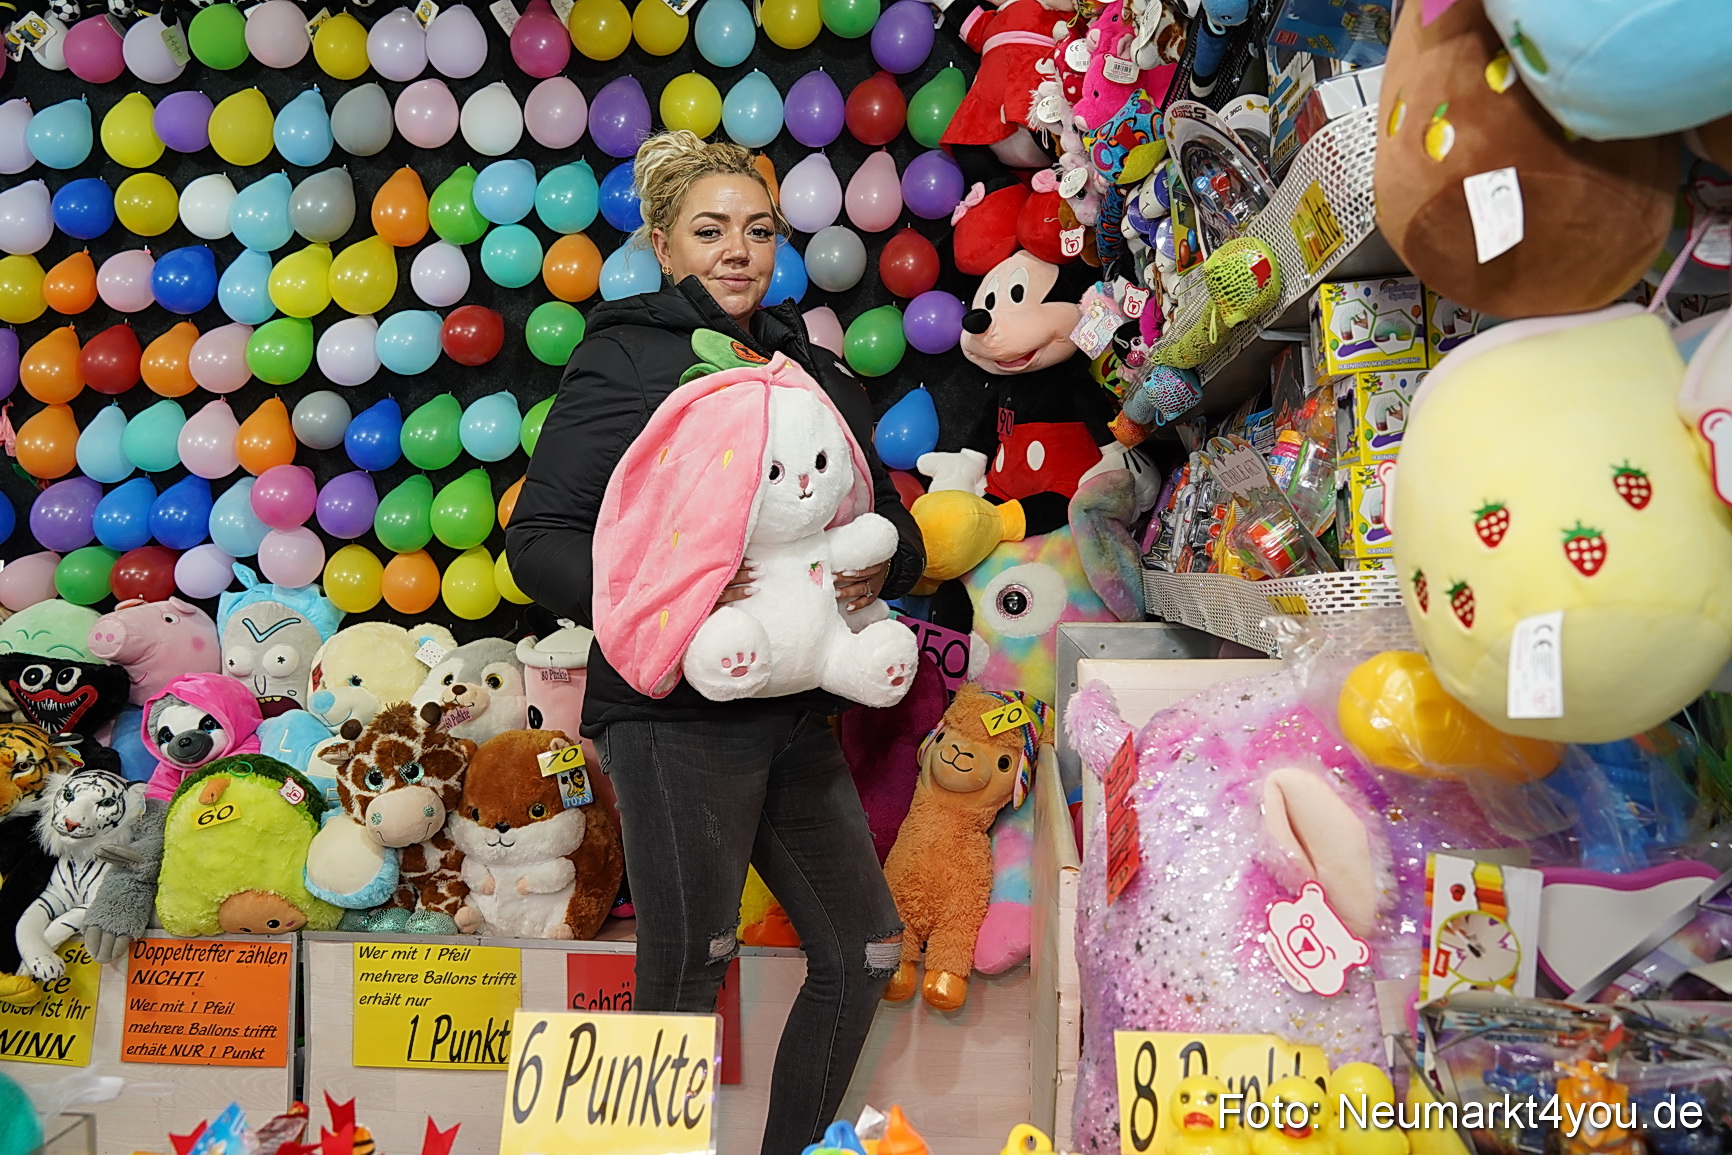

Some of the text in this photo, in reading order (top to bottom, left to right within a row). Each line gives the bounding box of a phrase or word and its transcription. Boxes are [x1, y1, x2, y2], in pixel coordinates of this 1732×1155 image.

[1338, 356, 1421, 370] RAINBOW MAGIC SPRING
[1000, 411, 1014, 435] 90
[990, 707, 1023, 731] 70
[545, 747, 579, 769] 70
[564, 793, 590, 807] TOYS
[197, 804, 236, 827] 60
[64, 943, 93, 965] sie
[133, 940, 288, 967] Doppeltreffer zählen
[359, 945, 472, 962] Wer mit 1 Pfeil
[131, 969, 205, 987] NICHT!
[359, 970, 518, 986] mehrere Ballons trifft
[41, 995, 64, 1018] ist
[65, 997, 92, 1020] ihr
[129, 998, 236, 1015] Wer mit 1 Pfeil
[359, 992, 432, 1007] erhält nur
[128, 1021, 278, 1038] mehrere Ballons trifft
[407, 1014, 511, 1064] 1 Punkt
[126, 1042, 266, 1060] erhält NUR 1 Punkt
[511, 1020, 708, 1130] 6 Punkte
[1130, 1040, 1158, 1153] 8
